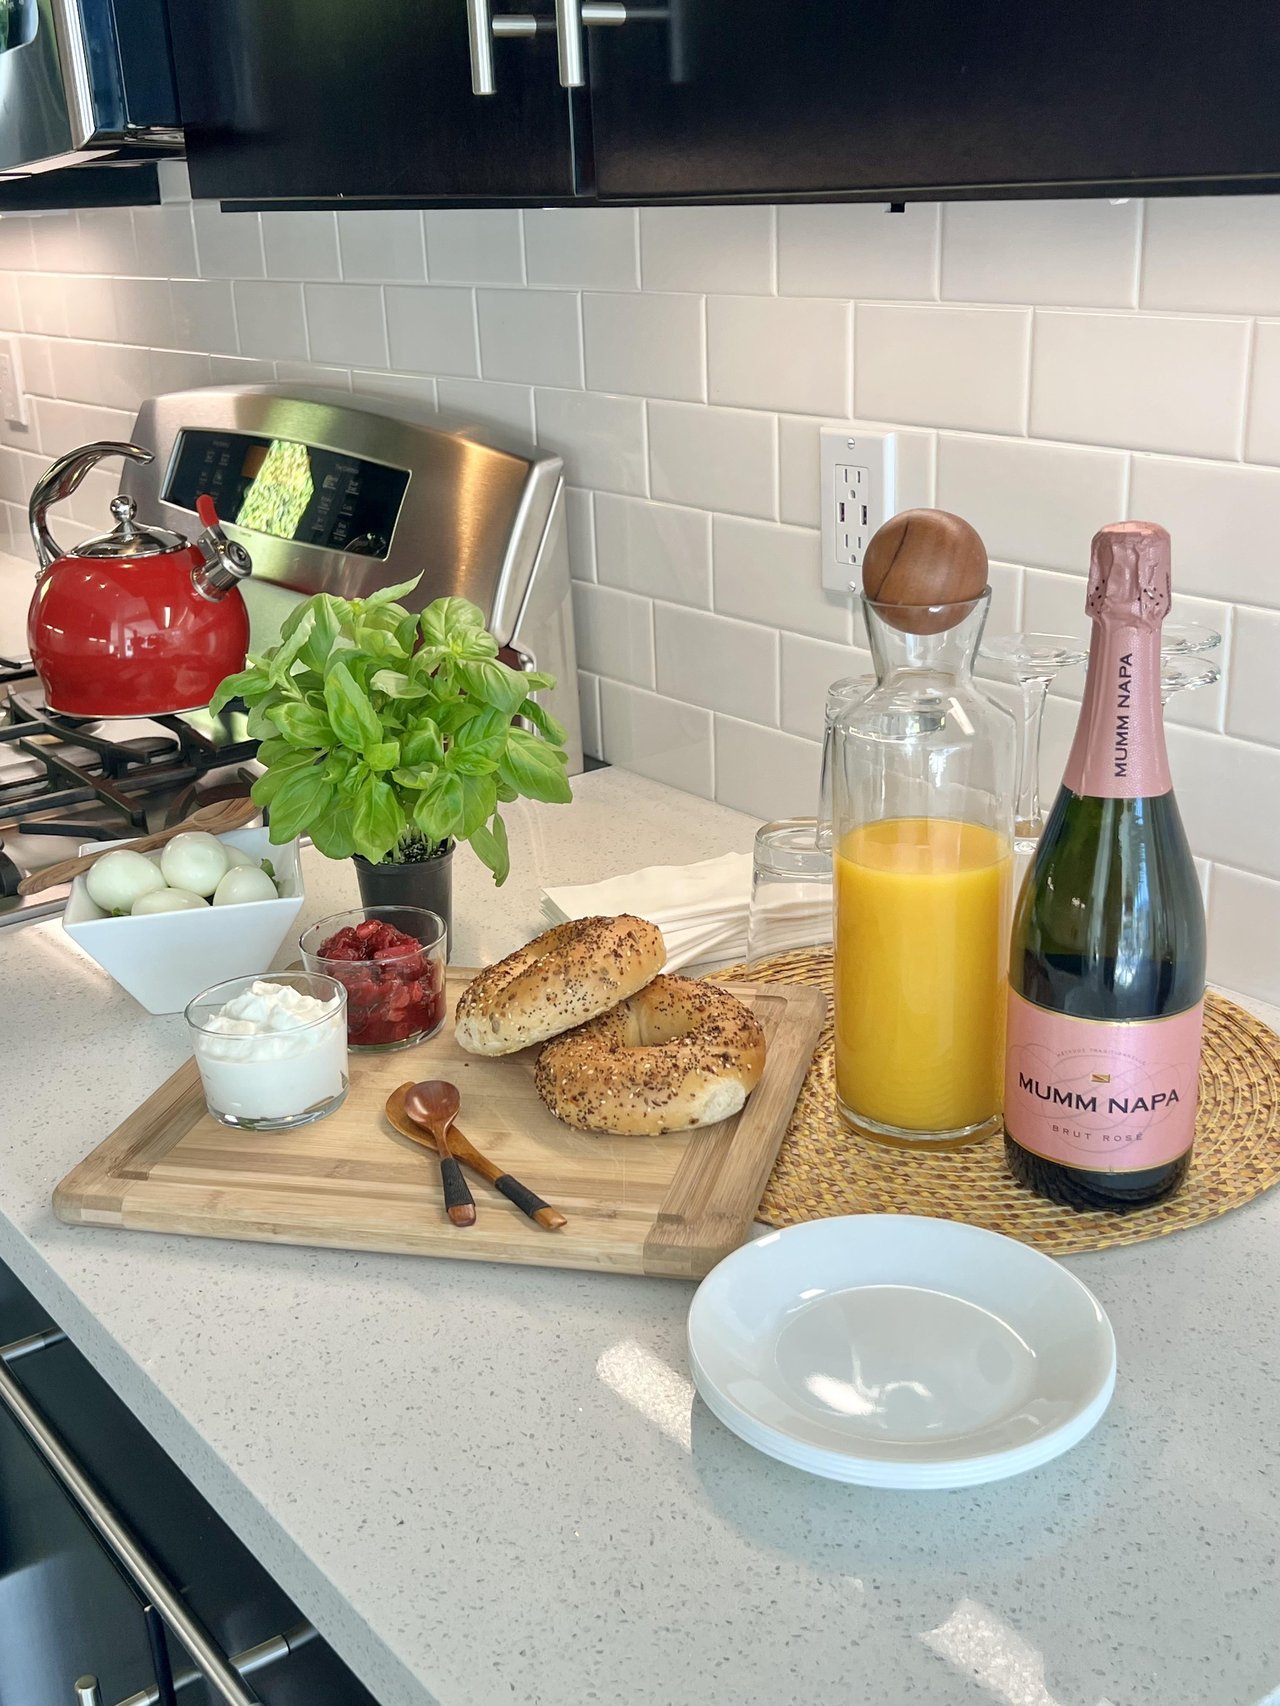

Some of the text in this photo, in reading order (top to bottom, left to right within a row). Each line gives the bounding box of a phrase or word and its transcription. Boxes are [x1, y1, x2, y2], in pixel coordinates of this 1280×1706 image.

[1114, 652, 1134, 778] MUMM NAPA
[1019, 1071, 1180, 1114] MUMM NAPA
[1052, 1124, 1145, 1142] BRUT ROSÉ
